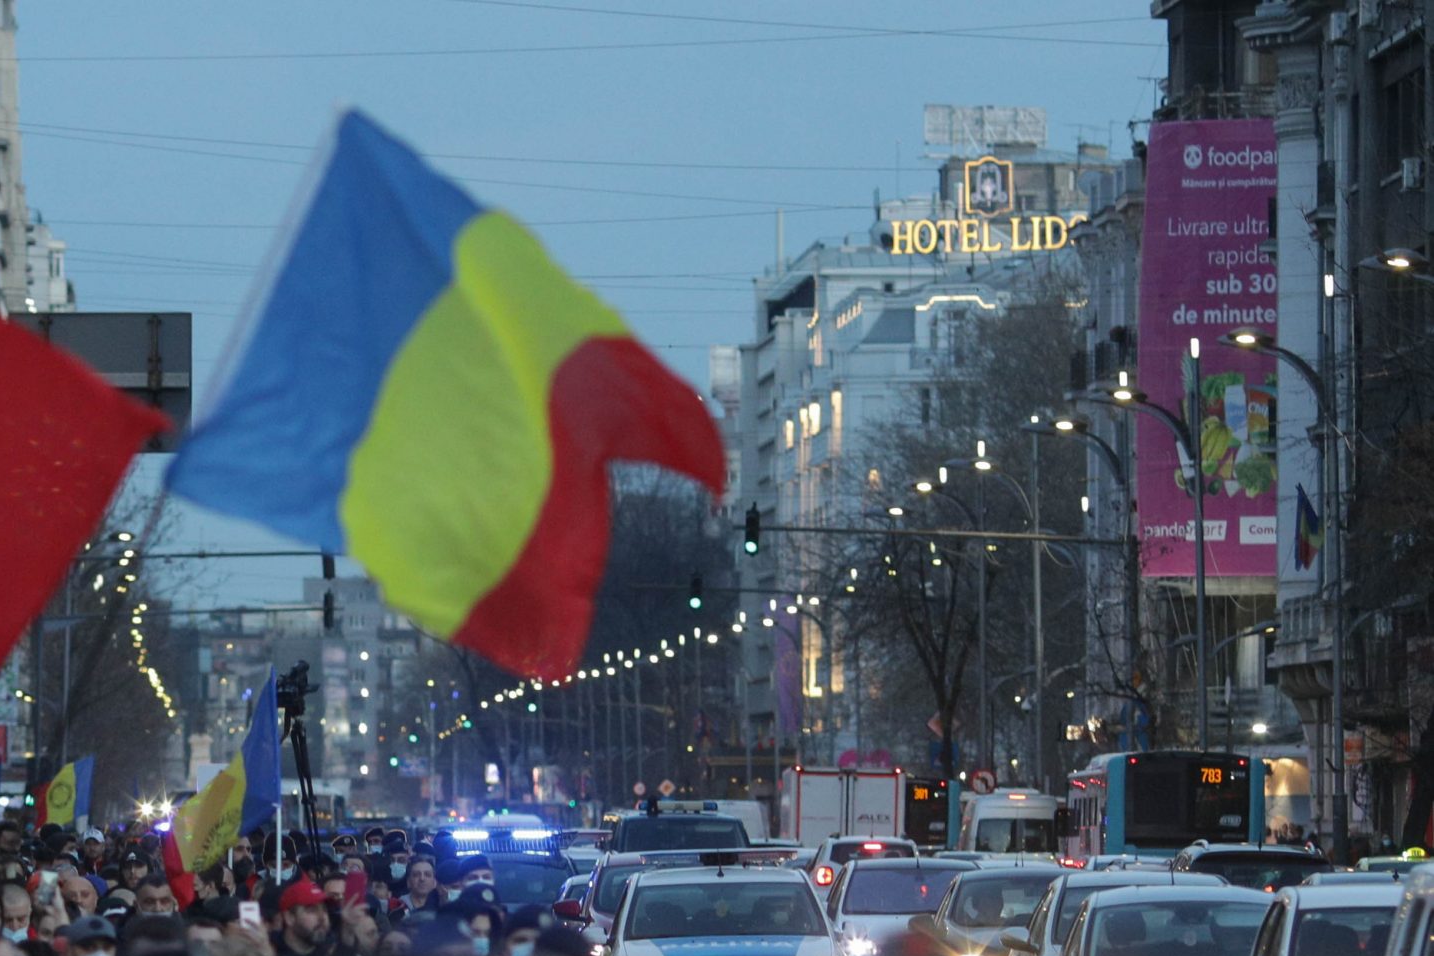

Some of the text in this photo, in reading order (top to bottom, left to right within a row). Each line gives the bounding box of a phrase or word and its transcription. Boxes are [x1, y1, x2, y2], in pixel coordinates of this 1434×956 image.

[891, 219, 1002, 254] HOTEL
[1168, 217, 1228, 236] Livrare
[1206, 273, 1277, 295] sub 30
[1172, 303, 1277, 325] de minute
[1201, 768, 1223, 783] 783
